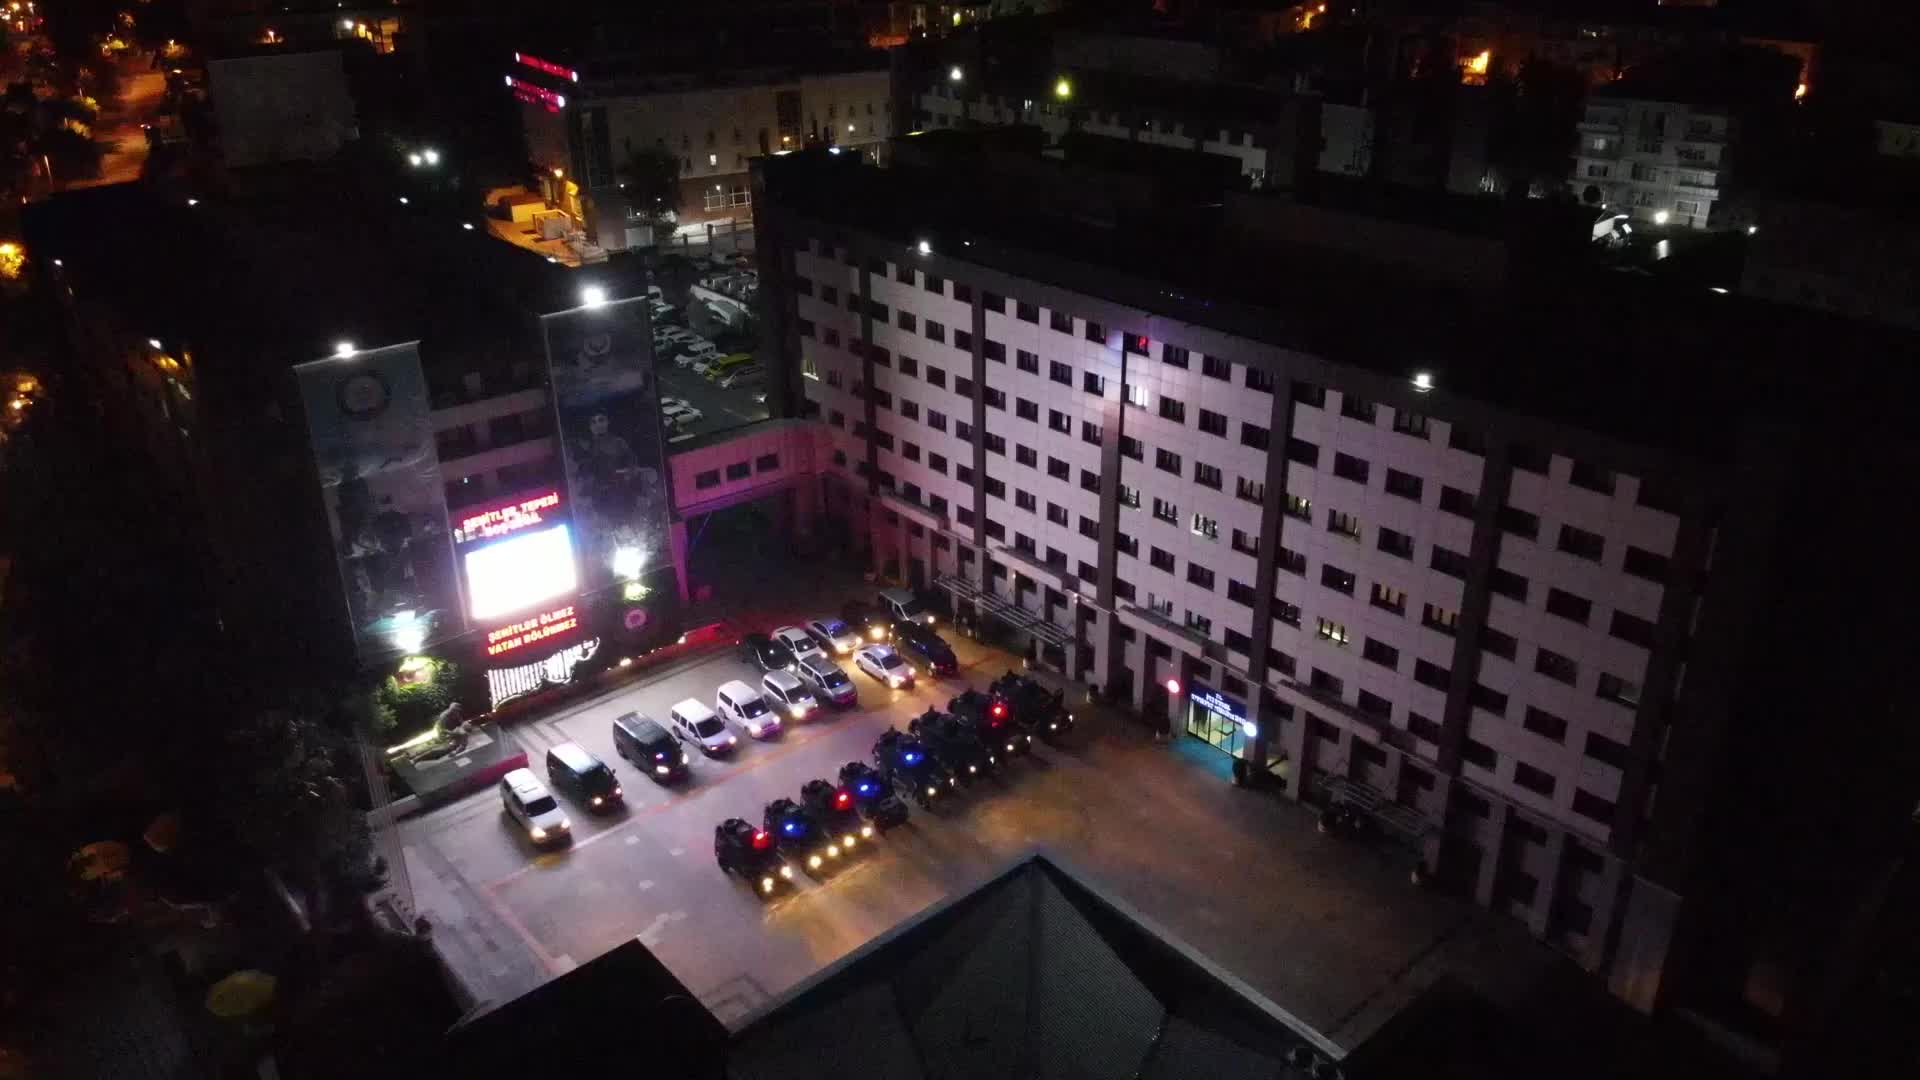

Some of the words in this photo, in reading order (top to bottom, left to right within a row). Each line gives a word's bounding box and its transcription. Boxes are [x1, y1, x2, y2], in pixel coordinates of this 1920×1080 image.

[540, 606, 574, 625] ÖLMEZ
[488, 637, 522, 655] VATAN
[523, 618, 577, 643] BÖLÜNMEZ
